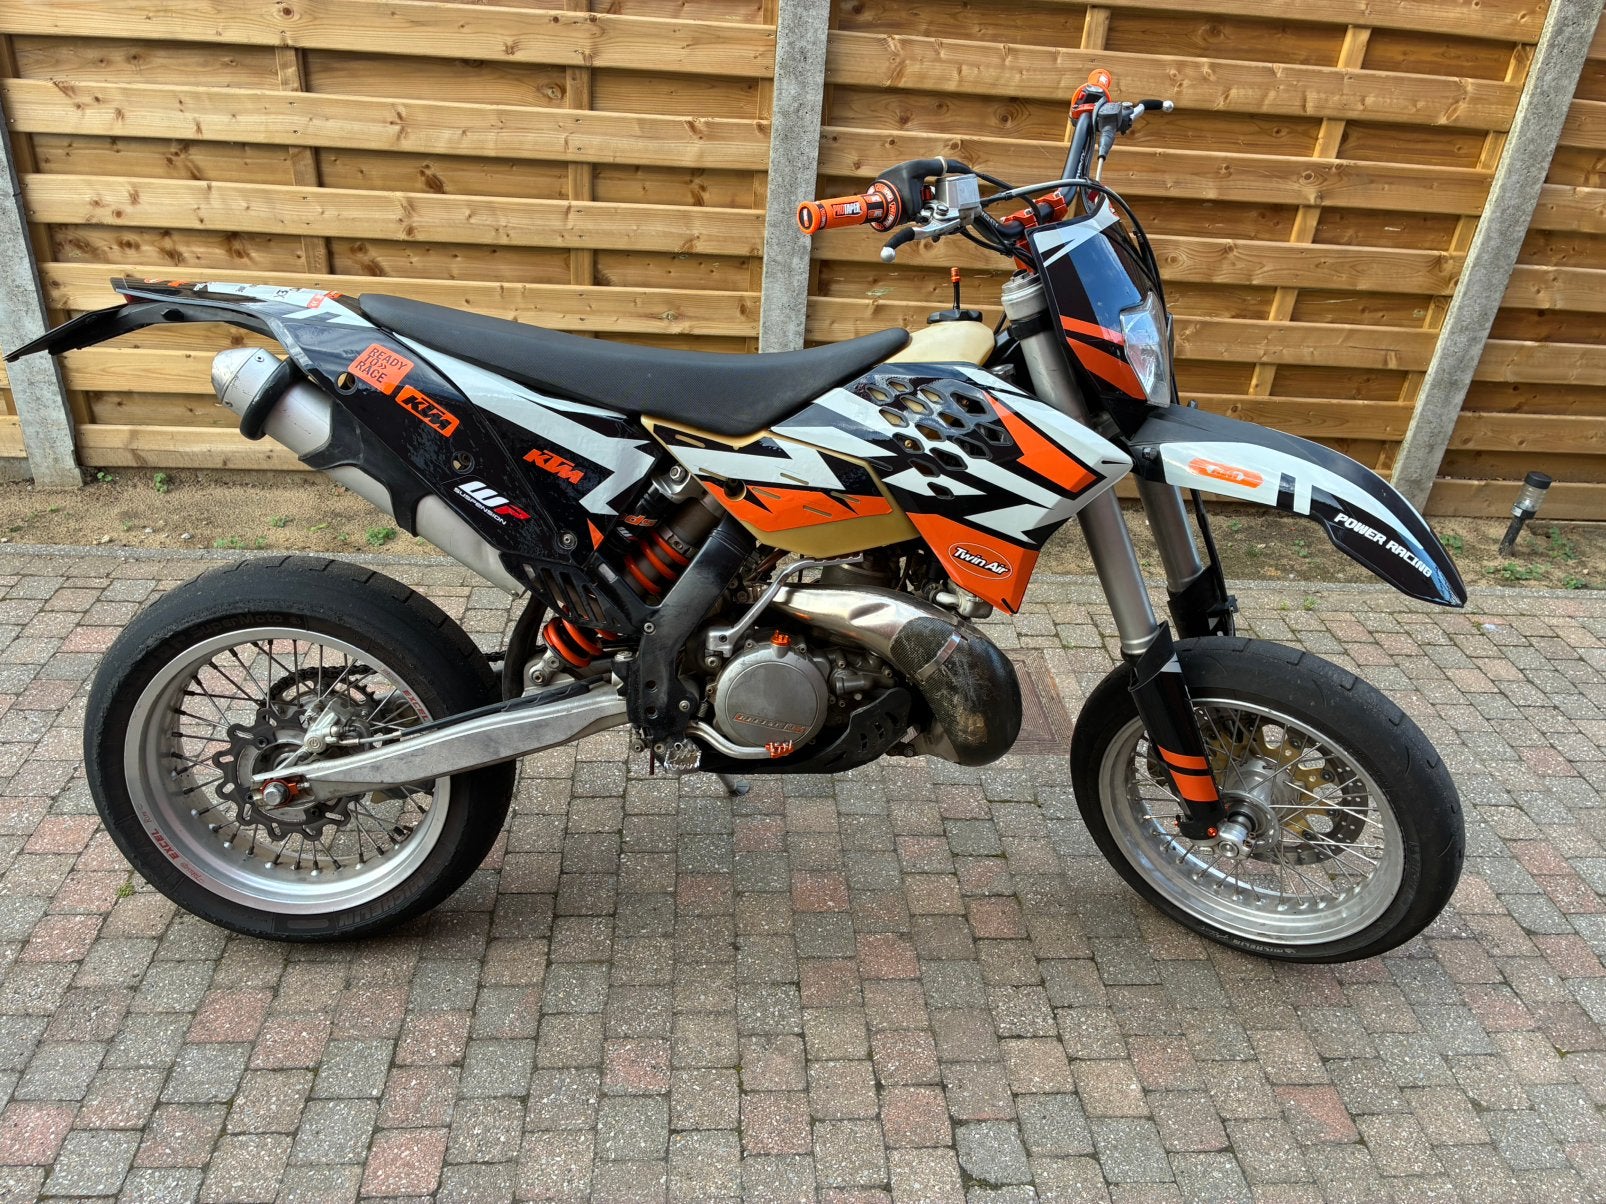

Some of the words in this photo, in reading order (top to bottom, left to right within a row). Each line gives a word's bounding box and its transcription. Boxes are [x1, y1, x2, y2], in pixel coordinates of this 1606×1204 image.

[355, 360, 388, 383] RACE
[368, 347, 408, 371] READY
[401, 394, 452, 431] KTM
[522, 448, 585, 485] KTM
[453, 486, 507, 525] SUSPENSION
[953, 546, 987, 567] Twin
[985, 561, 1009, 574] Air
[1333, 512, 1387, 546] POWER
[1385, 539, 1433, 578] RACING
[402, 689, 430, 721] EXCEL
[151, 828, 180, 860] EXCEL
